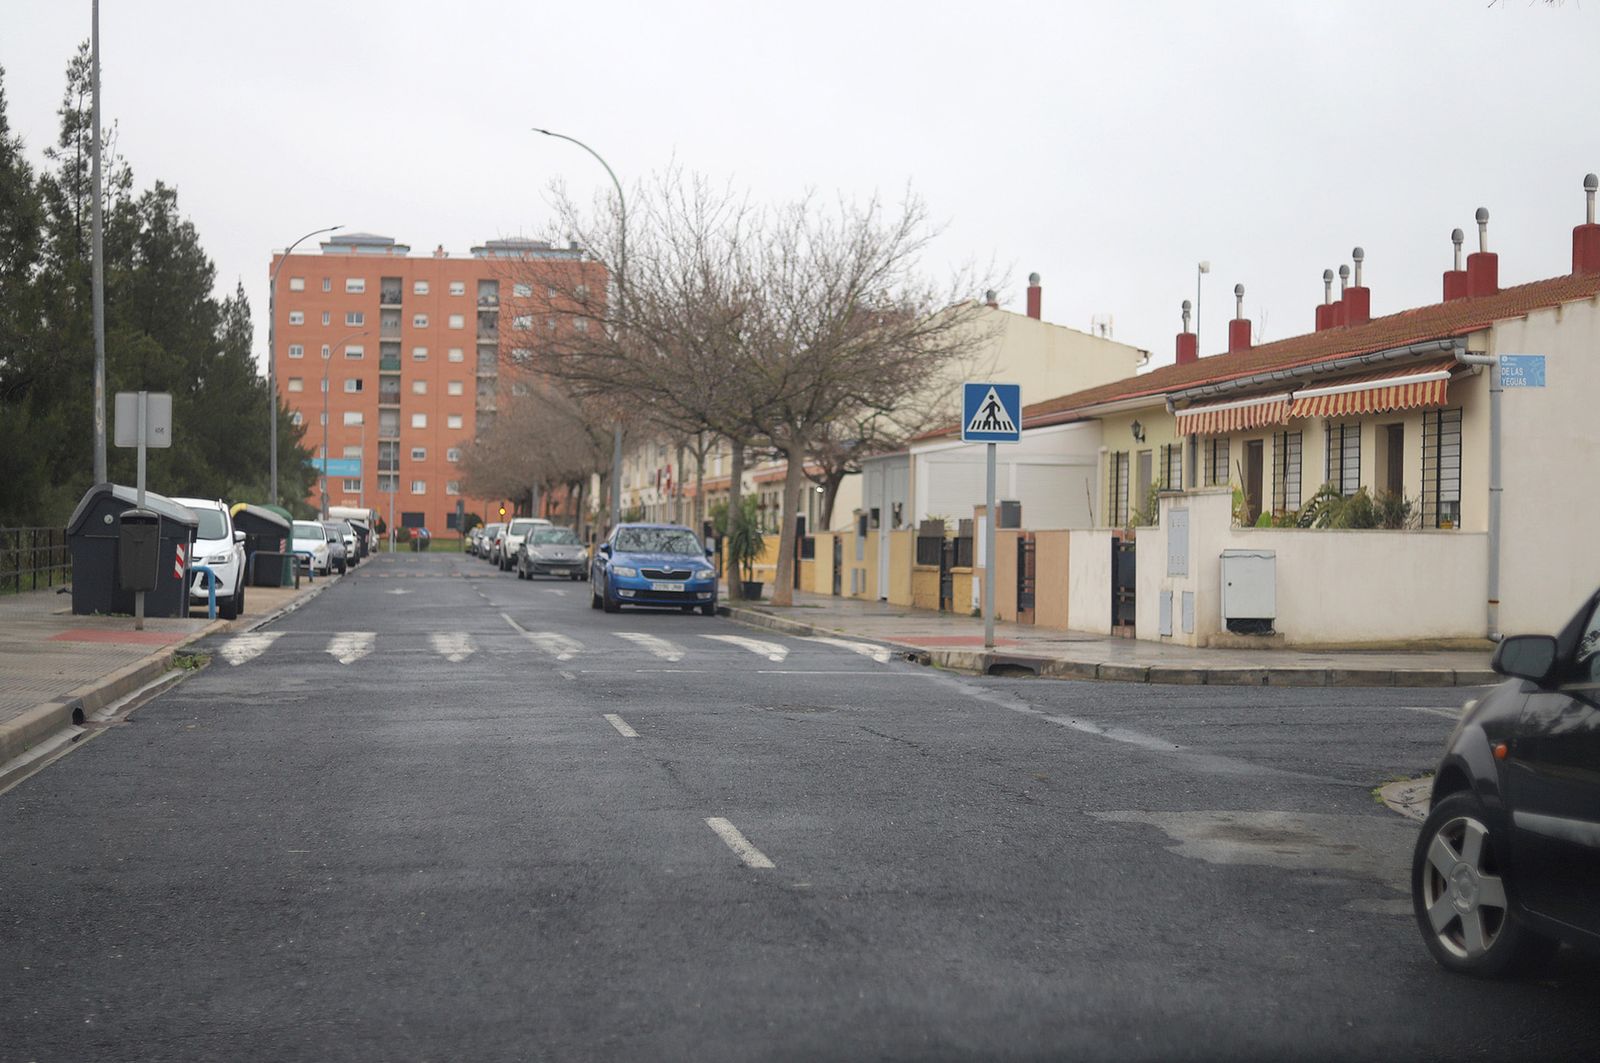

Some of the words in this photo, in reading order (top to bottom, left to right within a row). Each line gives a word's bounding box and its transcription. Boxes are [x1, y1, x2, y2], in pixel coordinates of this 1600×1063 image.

[1501, 367, 1510, 376] DE
[1511, 367, 1524, 376] LAS
[1502, 377, 1528, 386] YEGUAS
